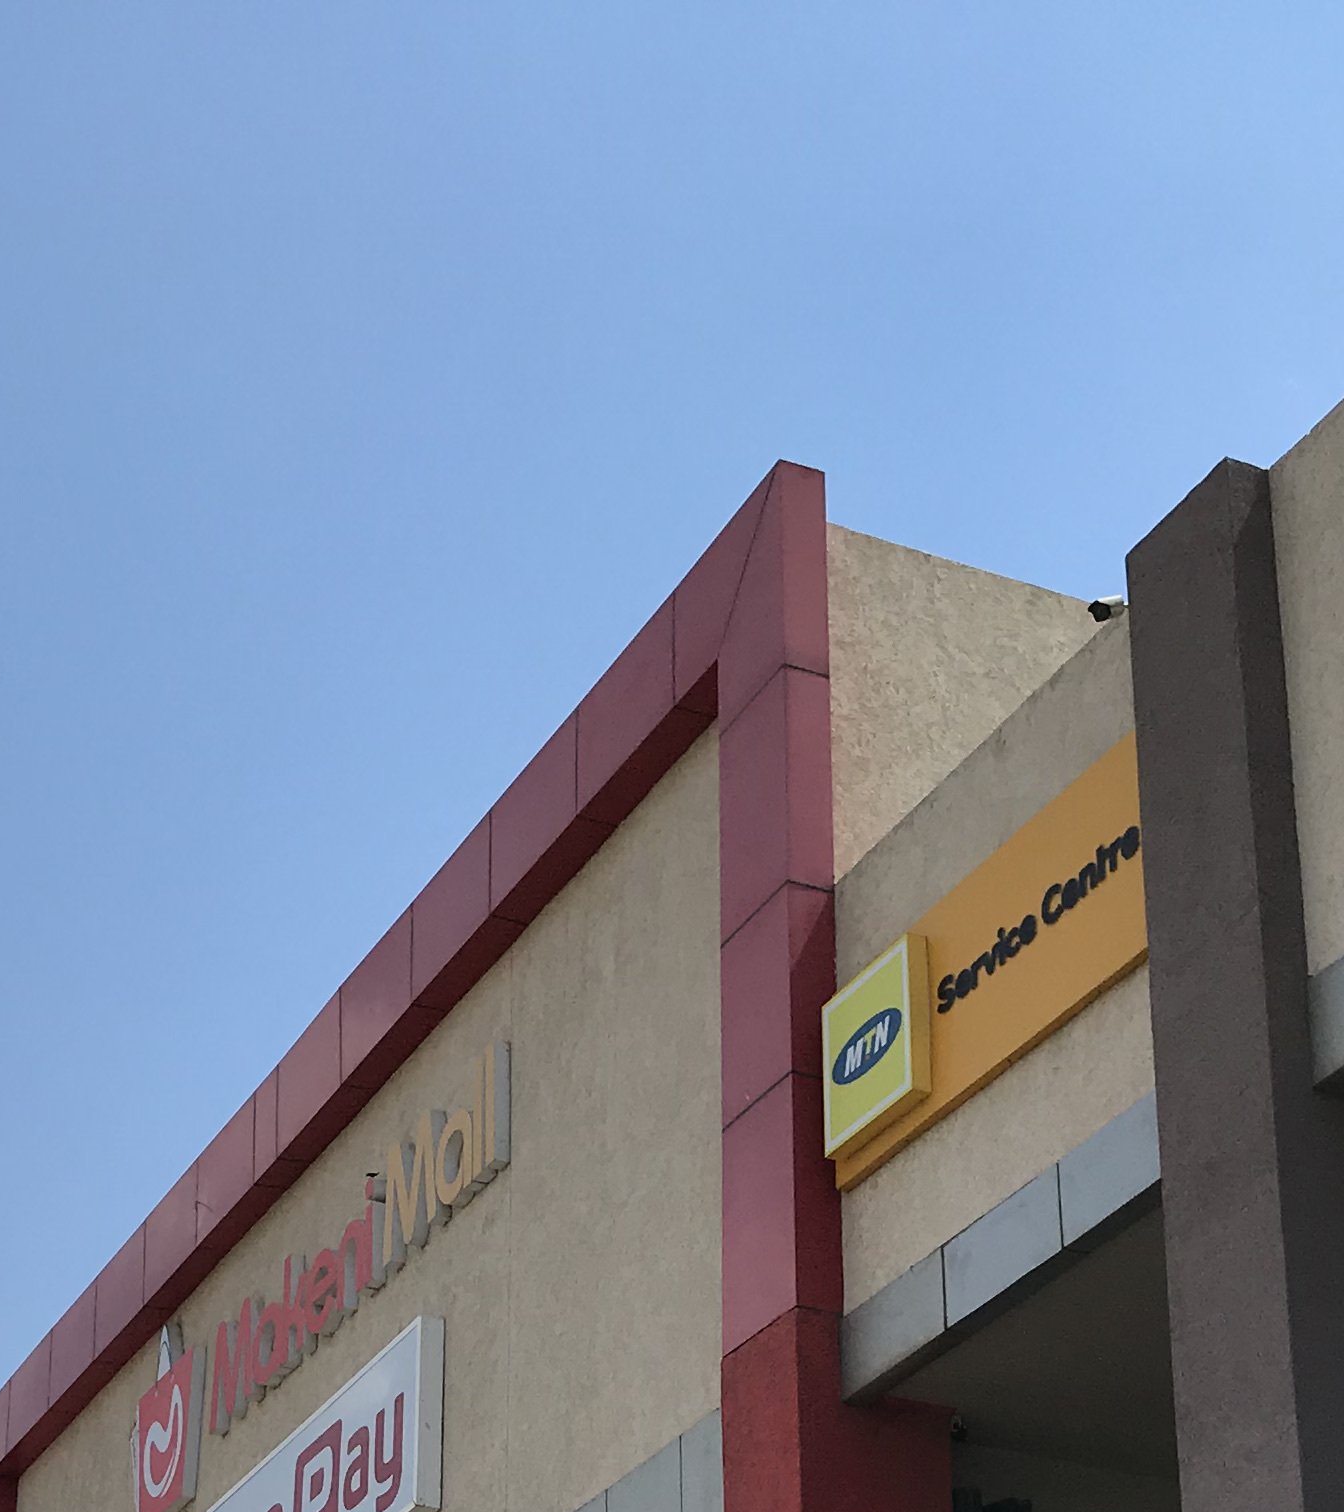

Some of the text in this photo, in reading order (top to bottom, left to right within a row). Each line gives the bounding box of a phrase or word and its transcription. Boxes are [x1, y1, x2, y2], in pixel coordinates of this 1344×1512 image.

[937, 826, 1141, 1014] Service Centre
[843, 1015, 891, 1078] MTN
[210, 1042, 502, 1435] Makeni Mall
